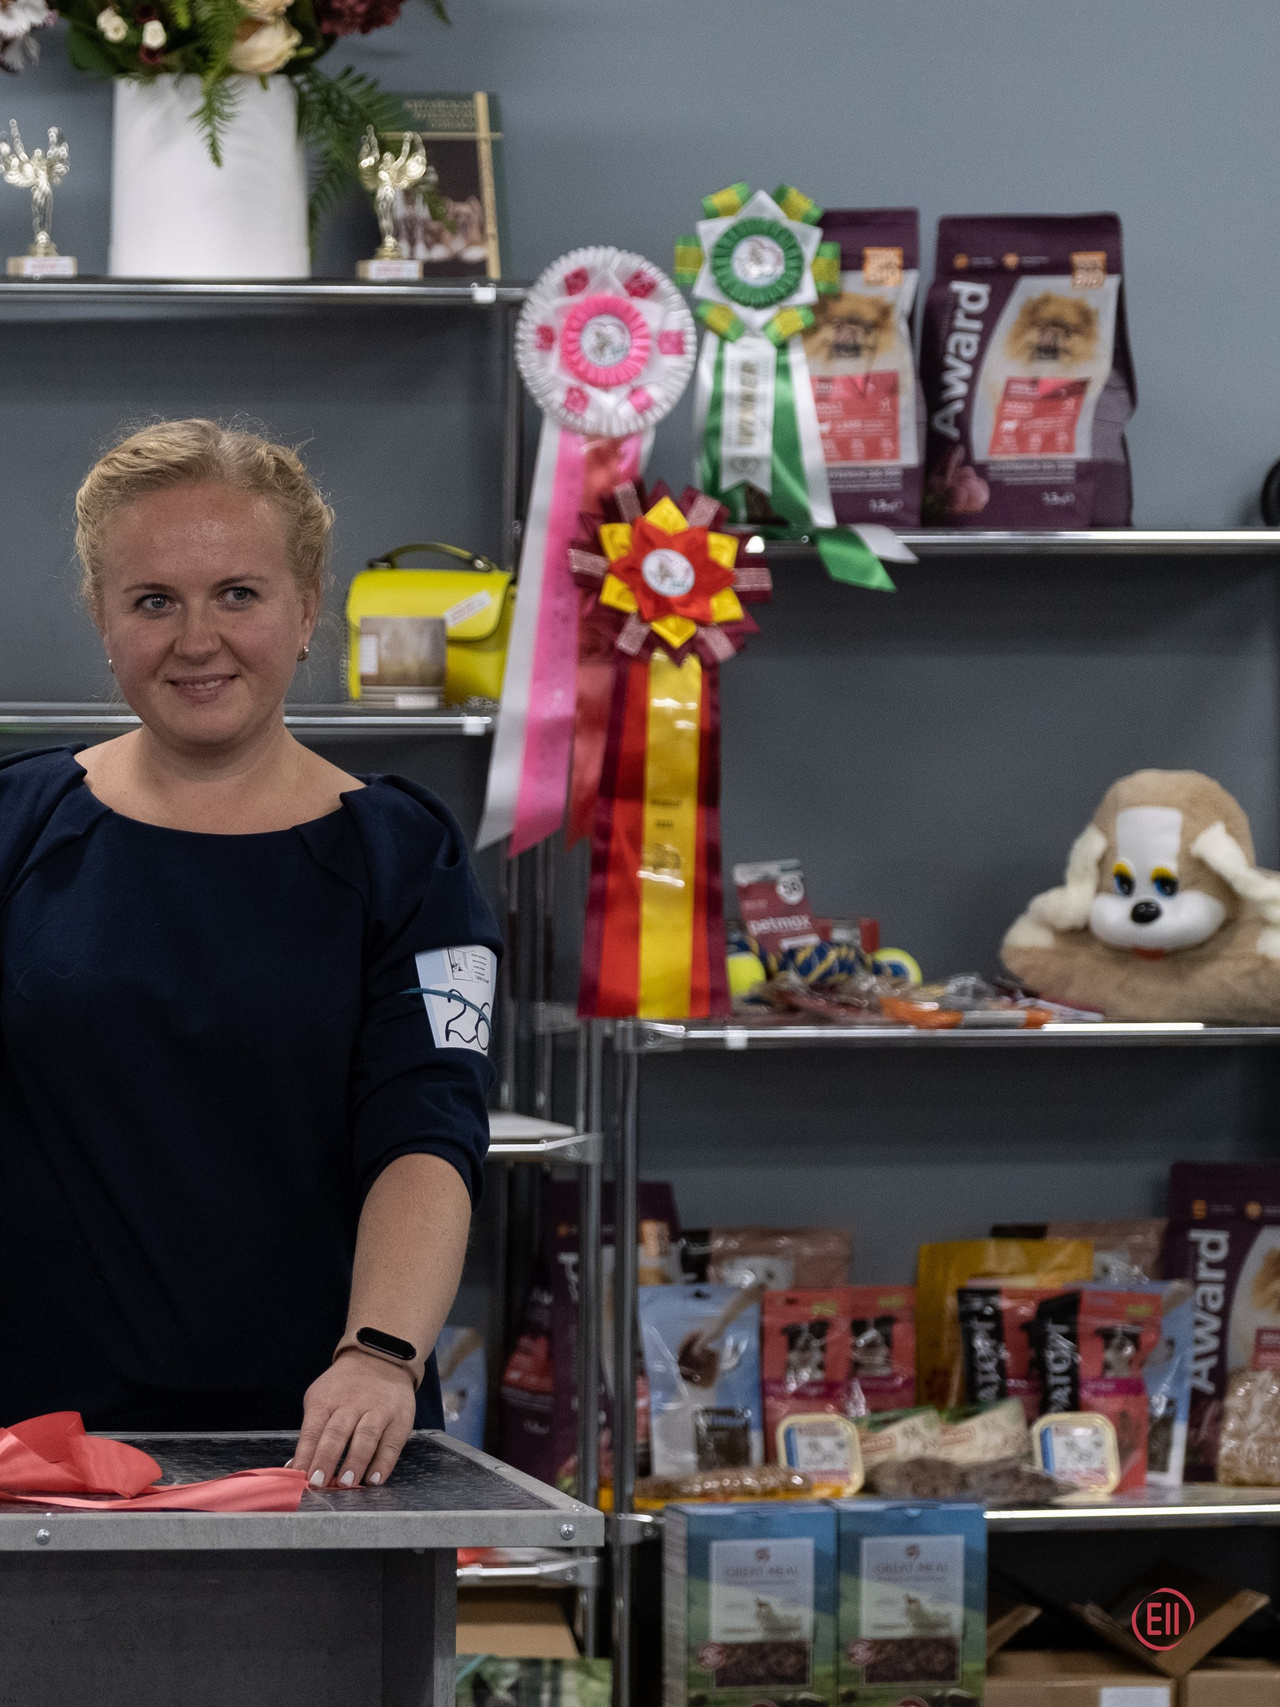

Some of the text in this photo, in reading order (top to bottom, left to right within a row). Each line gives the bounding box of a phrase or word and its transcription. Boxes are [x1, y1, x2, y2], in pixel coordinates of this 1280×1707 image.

[931, 280, 992, 441] Award
[748, 915, 812, 936] petmax
[1188, 1229, 1230, 1395] Award
